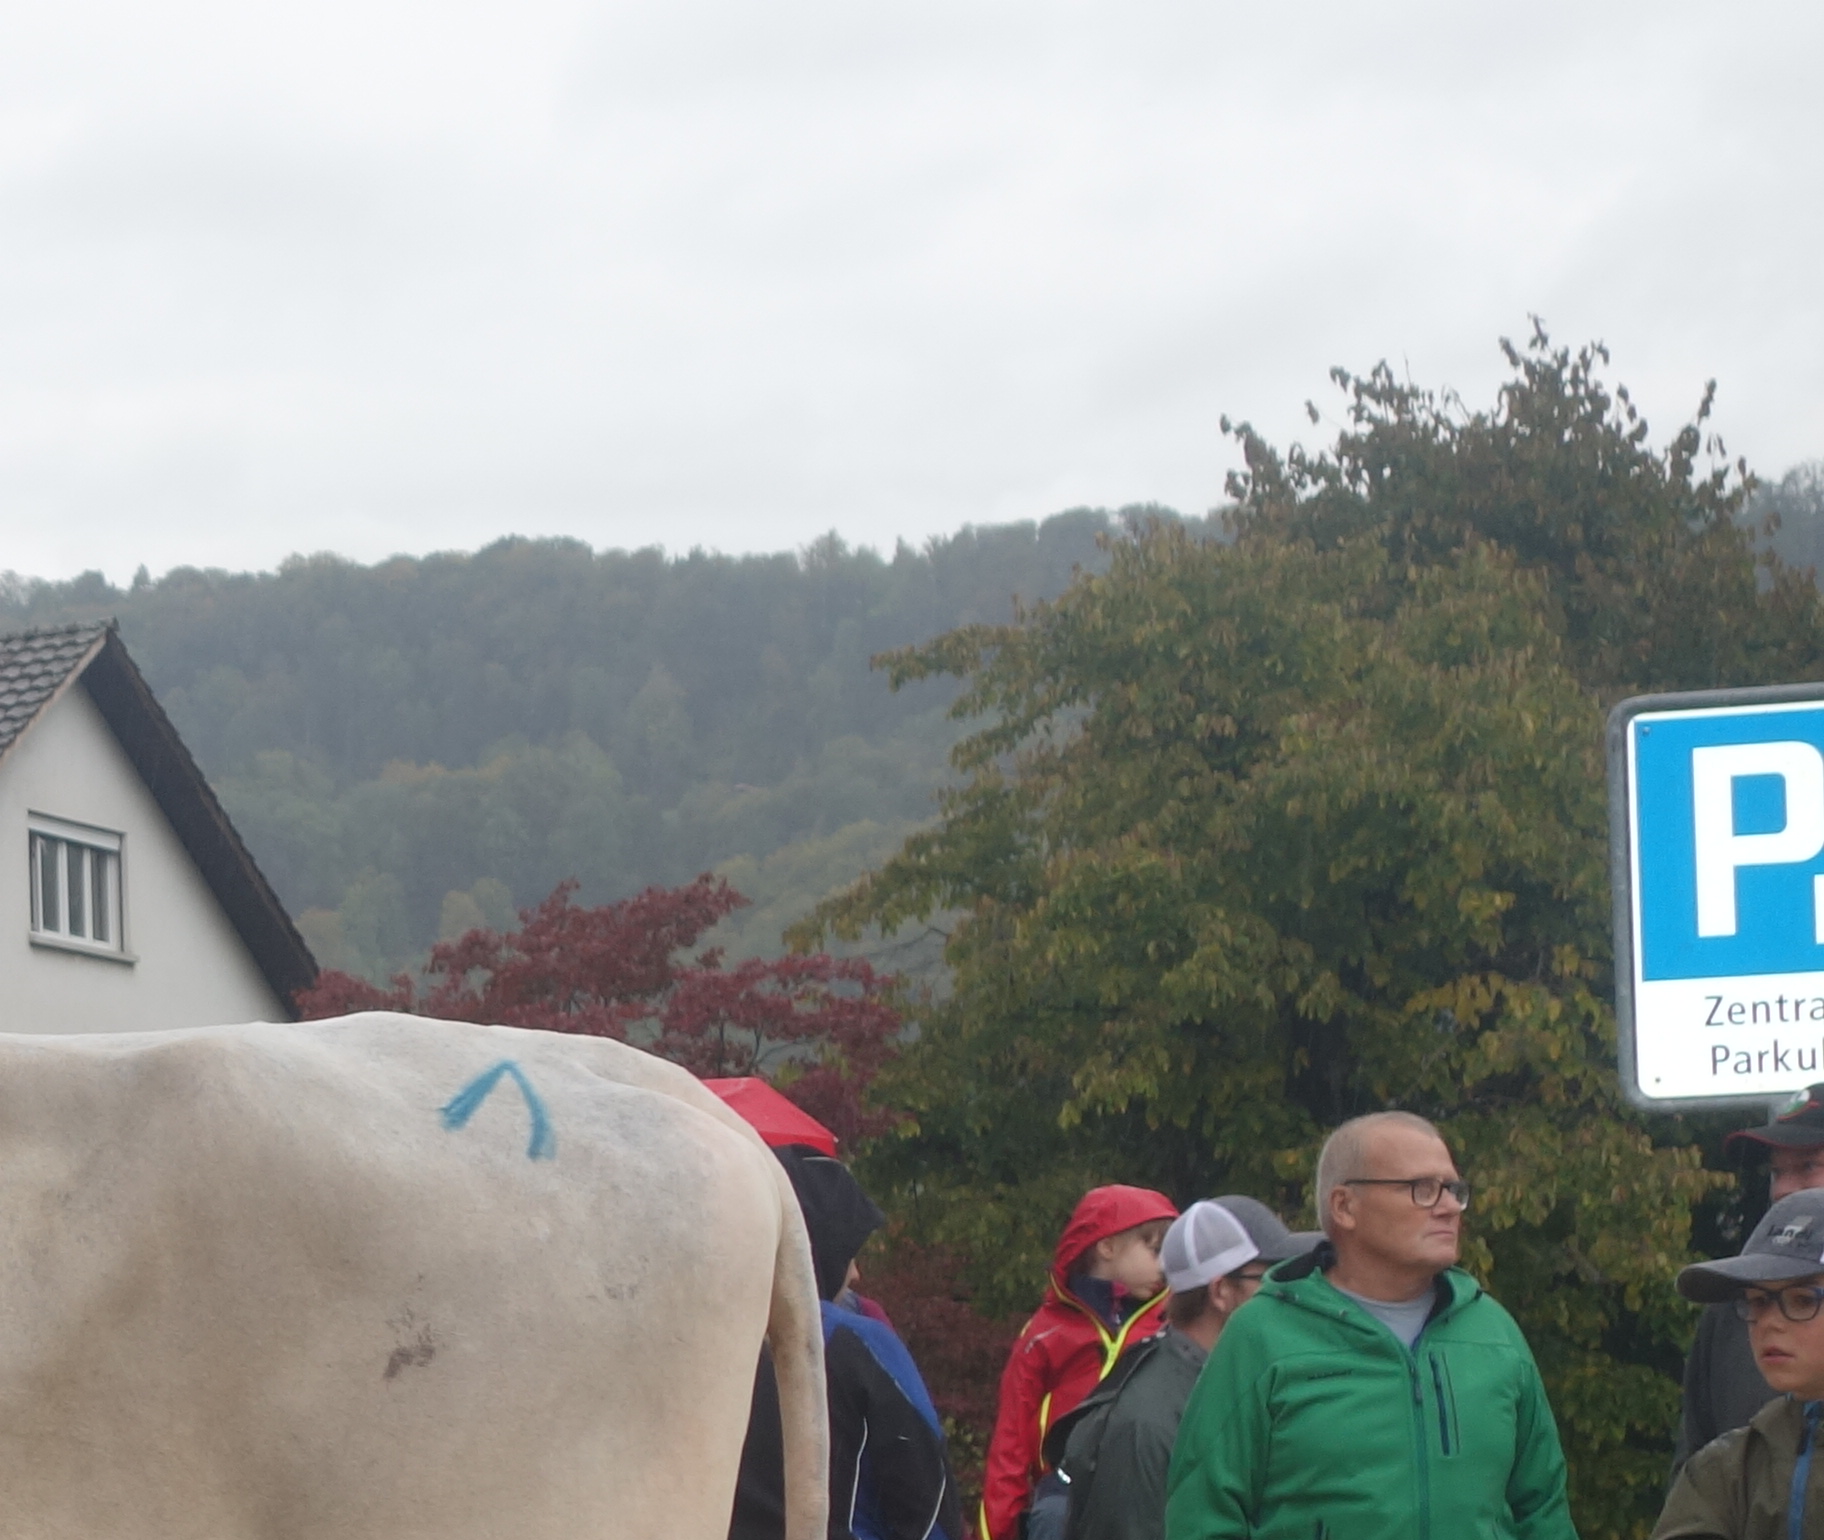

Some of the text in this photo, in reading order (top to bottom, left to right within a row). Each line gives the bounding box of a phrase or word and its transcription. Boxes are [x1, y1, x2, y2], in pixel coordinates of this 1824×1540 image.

[1692, 740, 1824, 938] P
[1704, 993, 1824, 1027] Zentra
[1711, 1036, 1824, 1076] Parku
